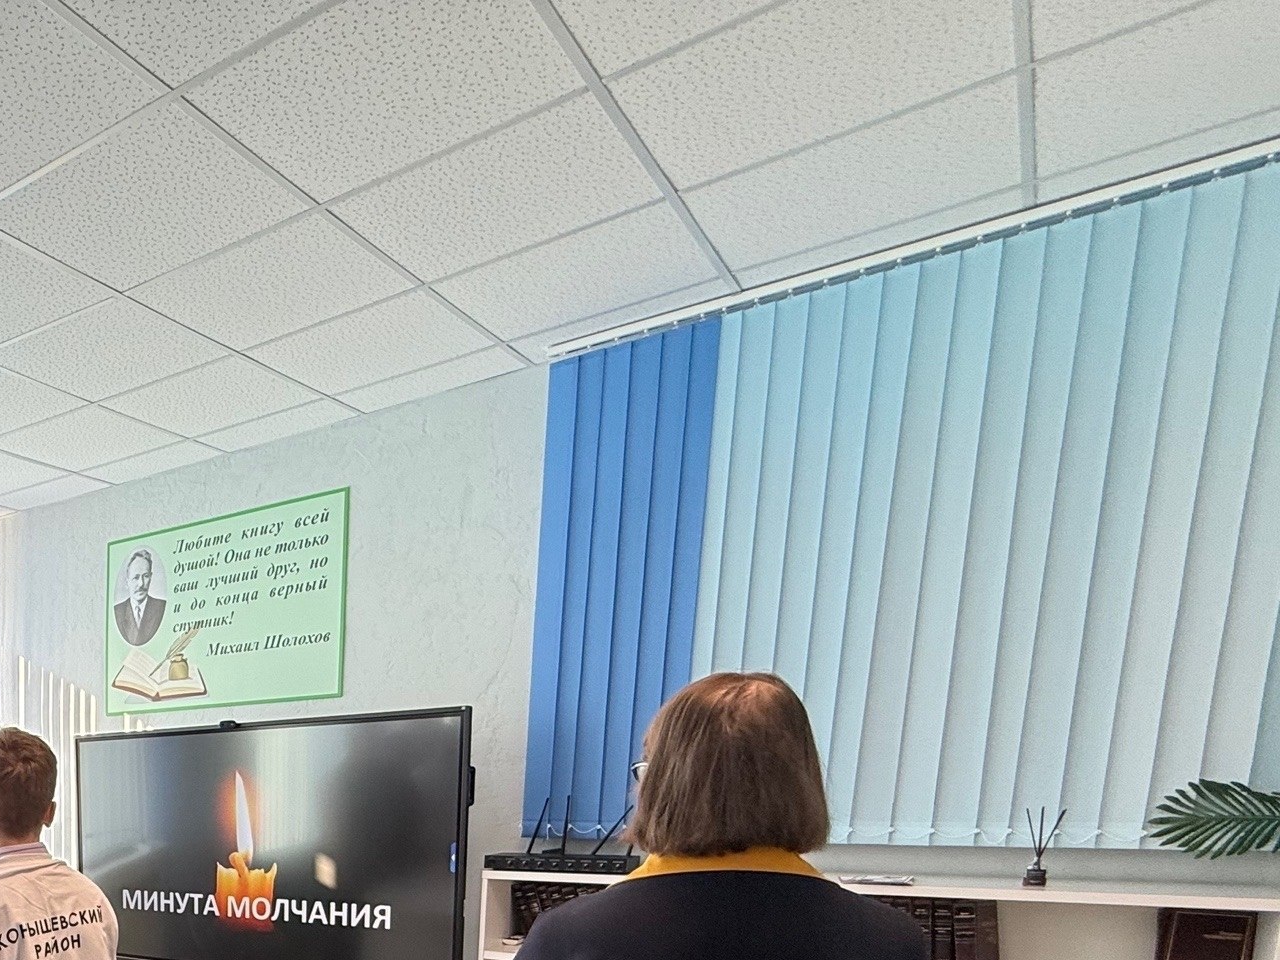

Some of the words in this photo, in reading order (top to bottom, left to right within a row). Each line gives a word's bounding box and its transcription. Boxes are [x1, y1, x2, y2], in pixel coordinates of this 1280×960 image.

[173, 532, 232, 554] Любите
[241, 520, 284, 540] книгу
[294, 508, 330, 528] всей
[173, 552, 220, 577] душой!
[224, 549, 251, 564] Она
[254, 545, 271, 558] не
[274, 534, 329, 554] только
[173, 580, 199, 594] ваш
[205, 566, 259, 590] лучший
[266, 562, 300, 580] друг,
[309, 556, 329, 569] но
[173, 603, 181, 614] и
[190, 597, 206, 611] до
[215, 590, 259, 606] конца
[269, 575, 328, 599] верный
[173, 611, 235, 634] спутник!
[206, 640, 260, 656] Михаил
[263, 631, 331, 650] Шолохов
[122, 889, 220, 916] МИНУТА
[226, 895, 392, 930] МОЛЧАНИЯ
[34, 934, 81, 960] РАЙОН
